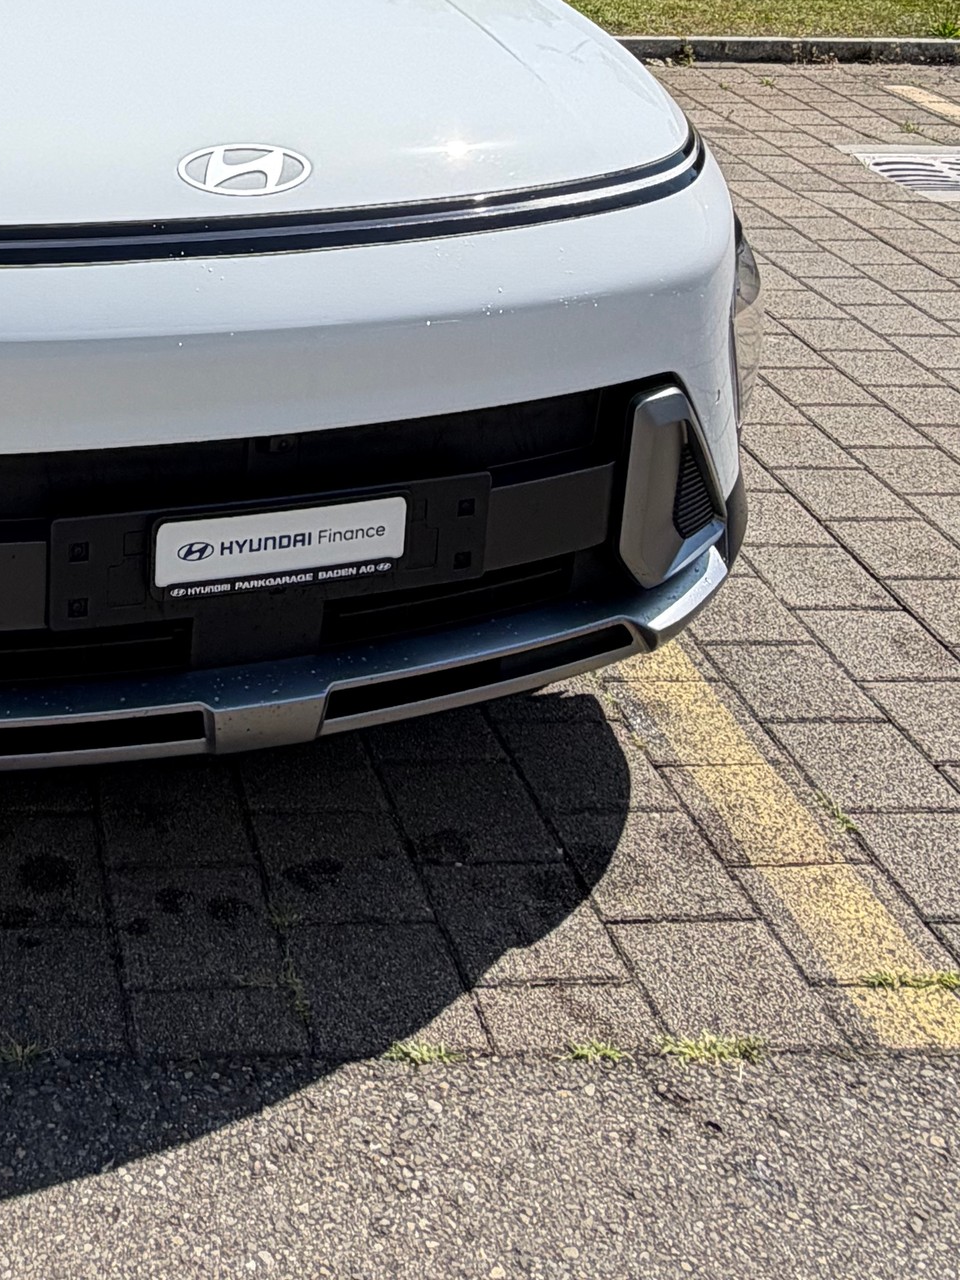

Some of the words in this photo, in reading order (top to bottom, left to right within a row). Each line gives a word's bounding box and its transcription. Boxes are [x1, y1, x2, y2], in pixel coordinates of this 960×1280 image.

[220, 532, 312, 556] HYUNDAI
[318, 524, 386, 544] Finance
[187, 583, 231, 596] HYUNDAI
[234, 573, 314, 591] PARKGARAGE
[318, 567, 357, 580] BADEN
[359, 564, 375, 574] AG
